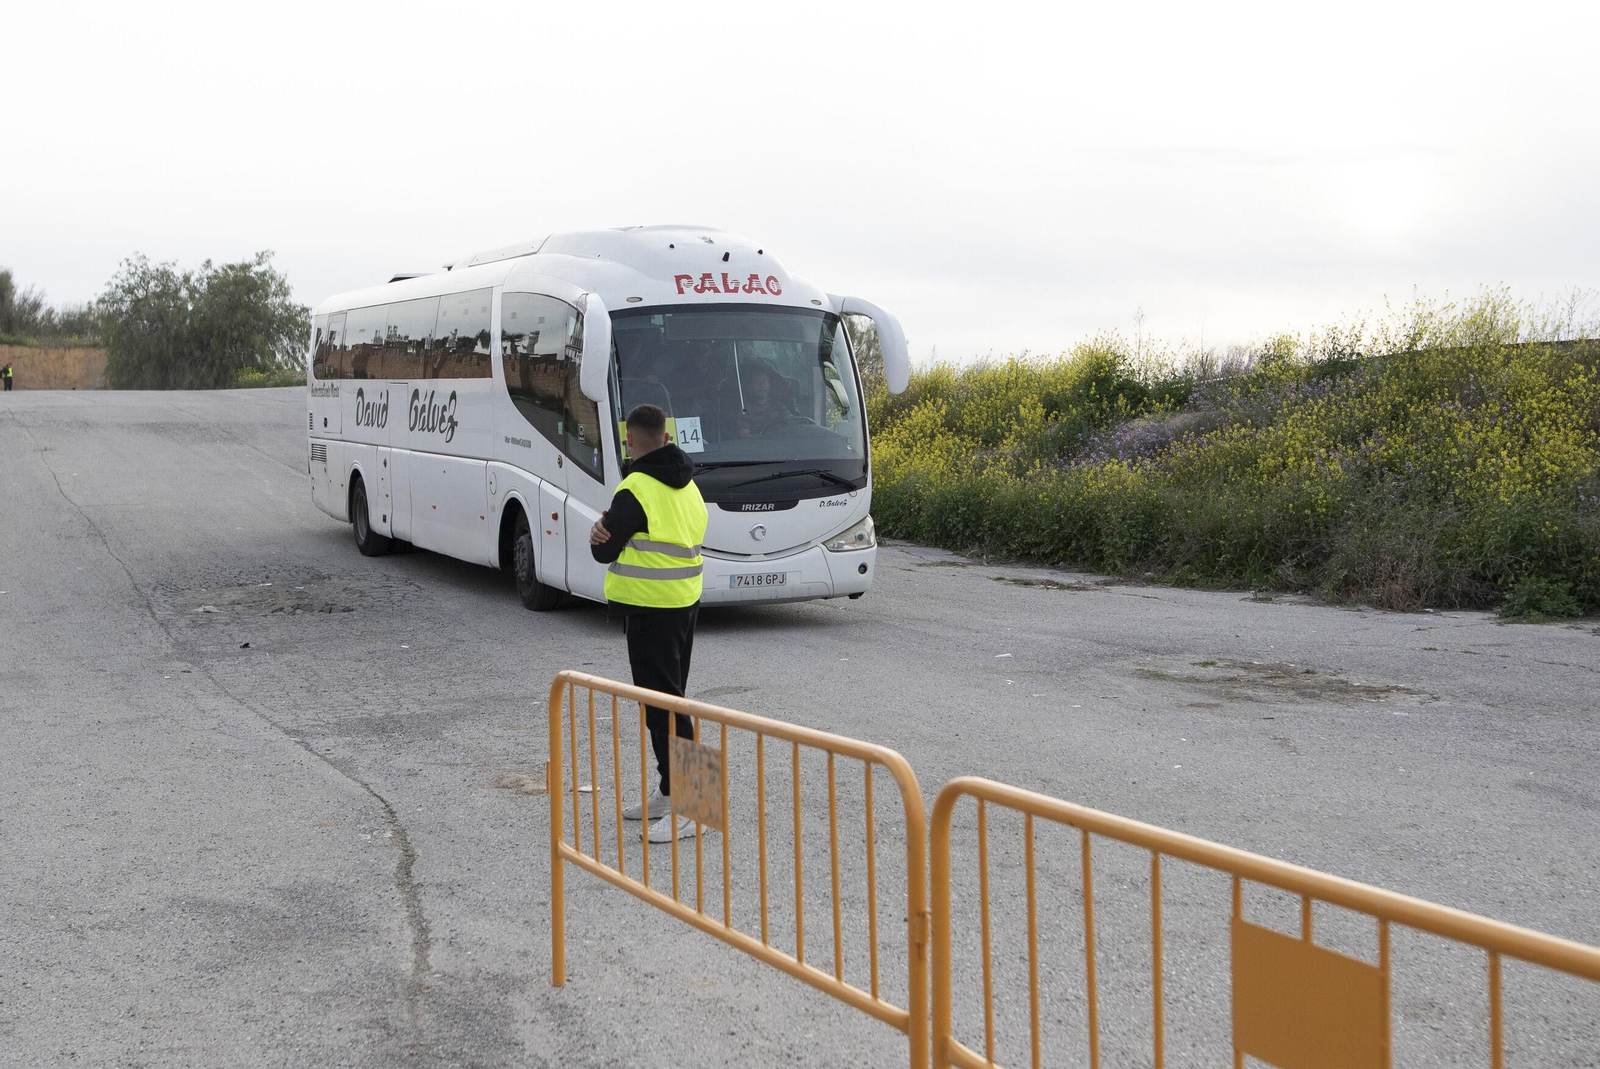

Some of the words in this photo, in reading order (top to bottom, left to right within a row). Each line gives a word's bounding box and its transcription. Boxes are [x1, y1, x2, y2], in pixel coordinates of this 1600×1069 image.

[356, 387, 389, 429] David
[680, 429, 700, 444] 14
[741, 503, 775, 511] IRIZAR
[736, 575, 763, 587] 7418
[765, 573, 785, 585] GPJ
